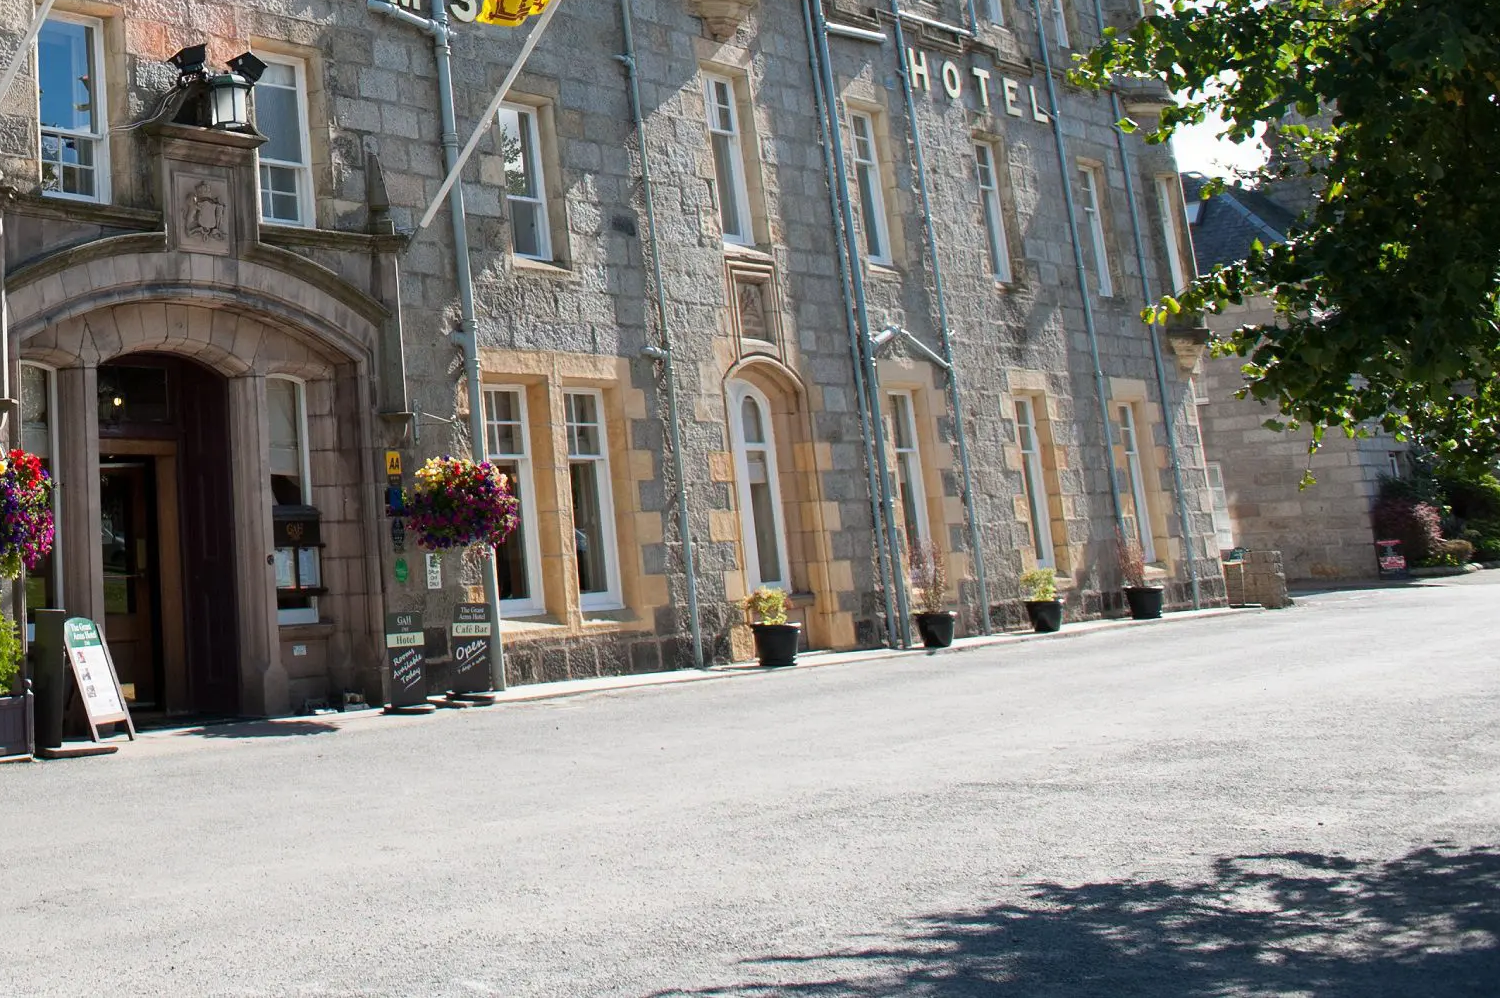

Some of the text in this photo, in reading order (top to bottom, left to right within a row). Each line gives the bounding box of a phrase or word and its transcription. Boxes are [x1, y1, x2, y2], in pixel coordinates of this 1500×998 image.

[908, 47, 1050, 124] HOTEL
[389, 457, 400, 470] AA
[455, 624, 488, 634] Café Bar
[396, 635, 416, 645] Hotel
[456, 639, 486, 660] Open
[400, 667, 421, 684] Today
